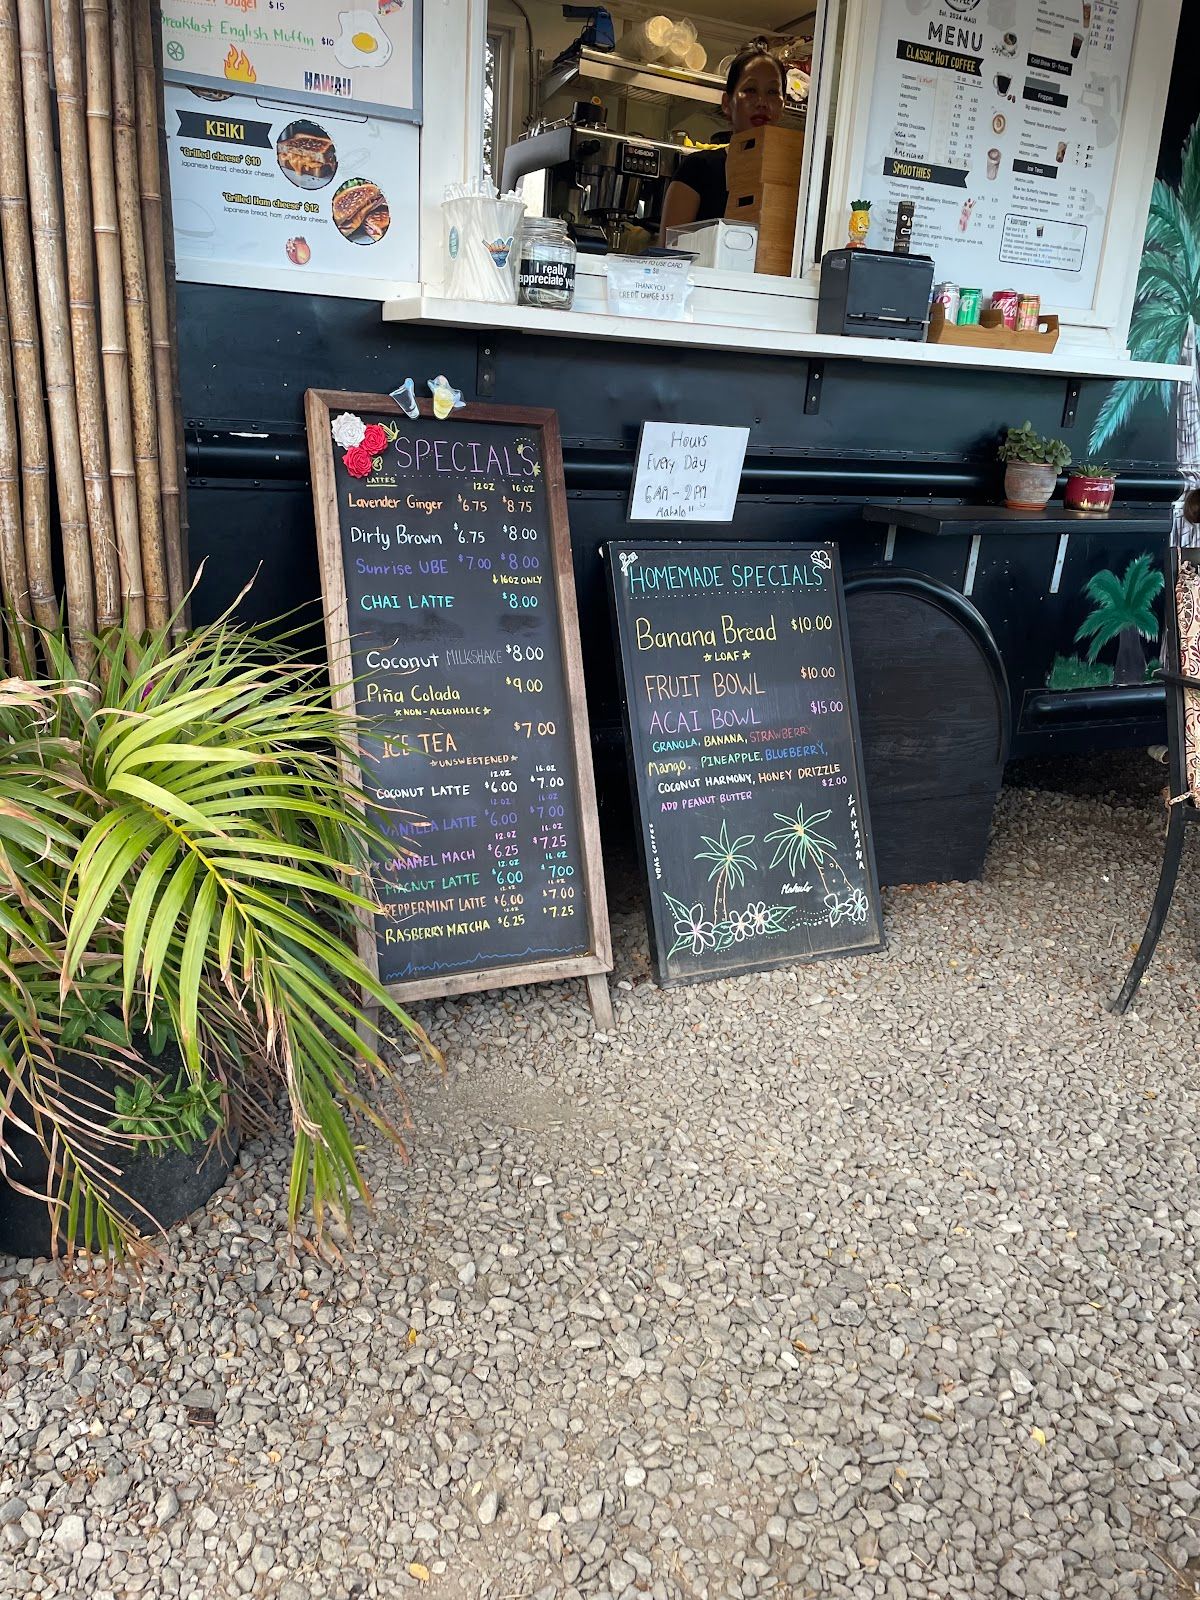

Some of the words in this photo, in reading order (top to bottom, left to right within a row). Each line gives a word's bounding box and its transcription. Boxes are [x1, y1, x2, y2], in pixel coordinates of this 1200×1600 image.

[220, 20, 269, 42] English
[273, 28, 315, 47] Muffin
[321, 36, 335, 47] $10
[927, 20, 984, 52] MENU
[906, 44, 935, 63] CLASSIC
[935, 50, 950, 67] HOT
[950, 56, 976, 73] COFFEE
[304, 71, 352, 97] HAWAII
[205, 119, 245, 141] KEIKI
[181, 160, 209, 171] Japanese
[209, 164, 228, 173] bread,
[254, 170, 275, 179] cheese
[244, 156, 262, 167] $10
[892, 160, 932, 180] SMOOTHIES
[223, 205, 250, 216] Japanese
[308, 216, 329, 225] cheese
[252, 195, 272, 208] Ham
[303, 202, 320, 214] $12
[519, 273, 564, 286] appreciate
[565, 277, 575, 289] yo
[535, 261, 540, 273] I
[542, 263, 568, 279] really
[635, 281, 653, 290] THANK
[653, 283, 666, 292] YOU
[671, 431, 709, 449] Hours
[394, 436, 536, 477] SPECIALS
[647, 453, 676, 474] Every
[683, 454, 707, 473] Day
[366, 476, 396, 485] LATTES
[348, 492, 401, 509] Lavender
[406, 494, 443, 514] Ginger
[457, 493, 488, 513] $6.75
[502, 495, 533, 513] $8.75
[644, 484, 669, 504] 6AM
[350, 526, 391, 551] Dirty
[396, 524, 443, 546] Brown
[453, 521, 486, 544] $6.75
[502, 524, 538, 541] $8.00
[356, 558, 413, 576] Sunrise
[418, 559, 449, 574] UBE
[500, 552, 540, 570] $8.00
[520, 575, 543, 585] ONLY
[629, 565, 724, 594] HOMEMADE
[731, 563, 824, 589] SPECIALS
[360, 593, 401, 611] CHAI
[408, 594, 456, 610] LATTE
[502, 591, 539, 610] $8.00
[635, 616, 717, 651] Banana
[720, 614, 778, 645] Bread
[790, 615, 833, 634] $10.00
[366, 650, 440, 670] Coconut
[445, 649, 503, 666] MILKSHAKE
[505, 643, 545, 663] $8.00
[714, 650, 740, 662] LOAF
[366, 682, 405, 703] Piña
[410, 684, 461, 703] Colada
[505, 676, 544, 694] $9.00
[644, 674, 702, 704] FRUIT
[712, 671, 766, 699] BOWL
[800, 666, 836, 680] $10.00
[649, 709, 702, 735] ACAI
[710, 707, 762, 731] BOWL
[810, 700, 844, 715] $15.00
[382, 734, 410, 760] ICE
[417, 731, 458, 755] TEA
[513, 721, 556, 739] $7.00
[703, 732, 748, 748] BANANA,
[438, 754, 510, 768] UNSWEETENED
[376, 785, 425, 800] COCONUT
[431, 784, 471, 798] LATTE
[484, 780, 518, 794] $6.00
[529, 774, 565, 790] $7.00
[657, 778, 701, 795] COCONUT
[704, 772, 756, 788] HARMONY,
[758, 769, 793, 783] HONEY
[797, 763, 841, 780] DRIZZLE
[821, 775, 848, 788] $2.00
[660, 802, 679, 813] ADD
[681, 794, 717, 810] PEANUT
[719, 790, 753, 803] BUTTER
[443, 815, 478, 831] LATTE
[484, 808, 518, 827] $6.00
[441, 848, 476, 865] MACH
[487, 843, 519, 859] $6.25
[532, 834, 567, 850] $7.25
[441, 872, 480, 891] LATTE
[491, 867, 524, 885] $6.00
[383, 898, 455, 917] PEPPERMINT
[458, 895, 487, 912] LATTE
[493, 893, 524, 907] $6.00
[542, 886, 575, 900] $7.00
[384, 925, 445, 947] RASBERRY
[446, 919, 491, 939] MATCHA
[497, 913, 526, 929] $6.25
[542, 904, 575, 919] $7.25
